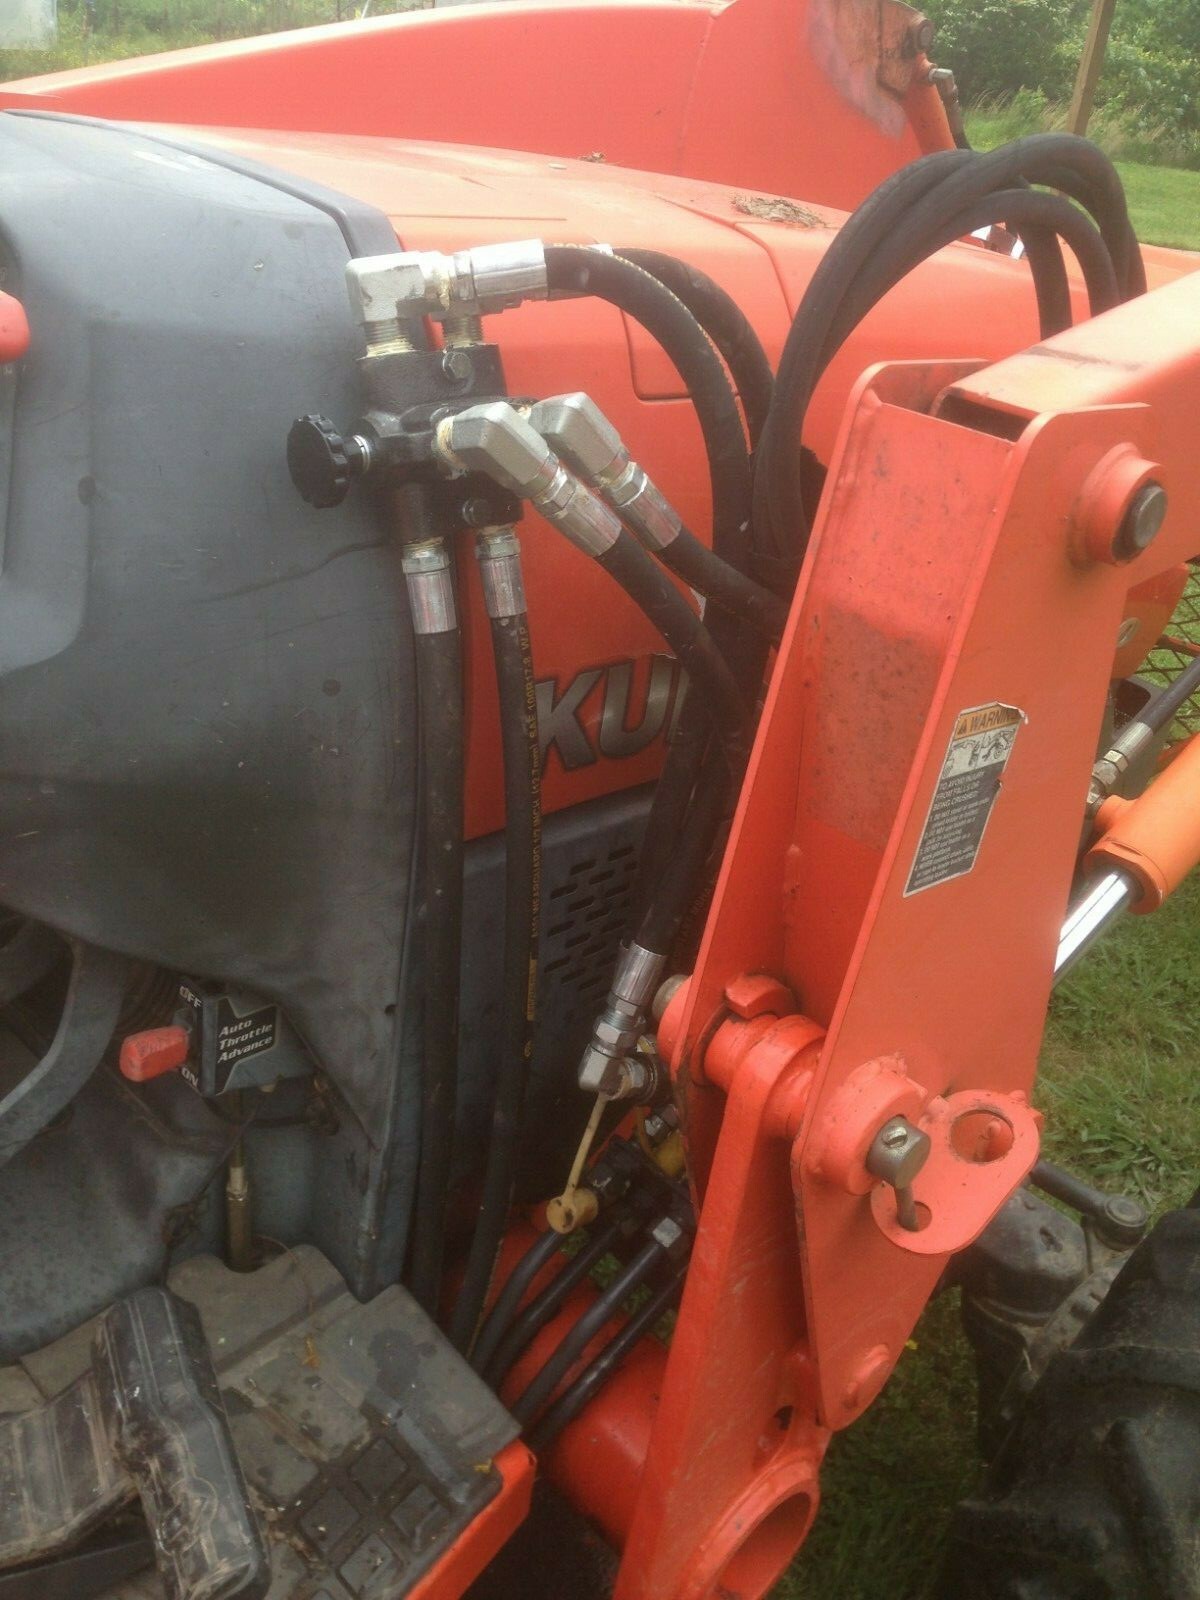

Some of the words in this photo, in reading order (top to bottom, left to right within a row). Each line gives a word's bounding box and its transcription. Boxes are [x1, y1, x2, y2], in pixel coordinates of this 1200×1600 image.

[535, 656, 690, 773] KU
[179, 986, 201, 1008] OFF
[219, 1019, 252, 1039] Auto
[219, 1024, 272, 1050] Throttle
[217, 1036, 272, 1063] Advance
[181, 1067, 199, 1088] ON
